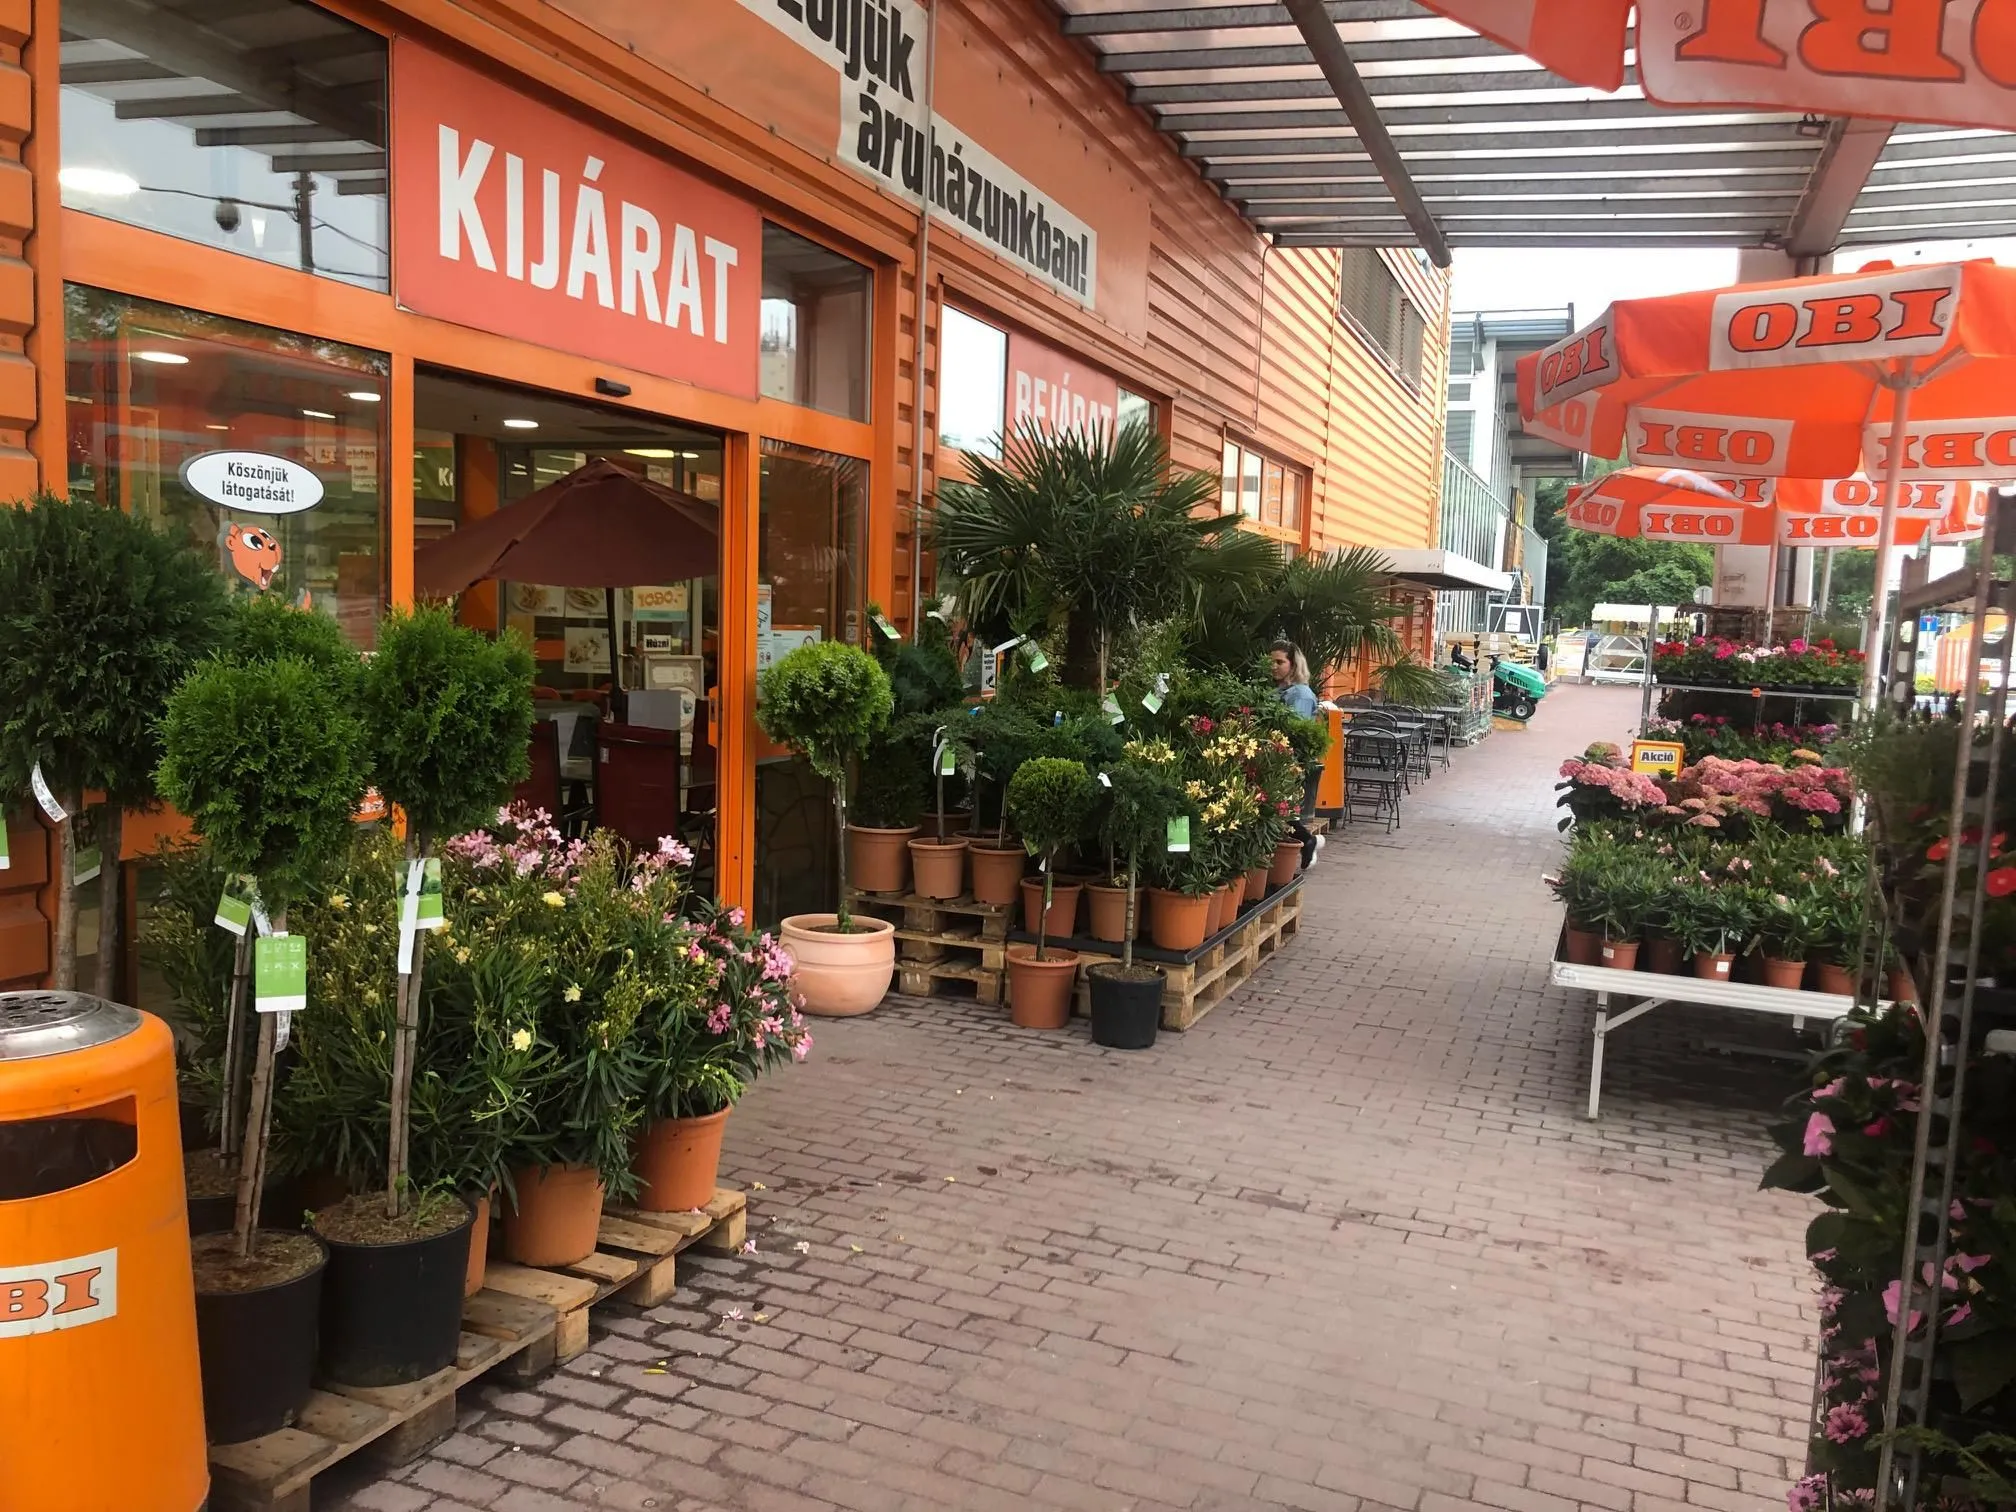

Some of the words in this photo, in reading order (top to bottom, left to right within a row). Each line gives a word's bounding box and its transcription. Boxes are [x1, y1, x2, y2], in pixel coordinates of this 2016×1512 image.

[777, 0, 915, 103] ljük
[857, 80, 1089, 297] áruházunkban!
[438, 123, 738, 345] KIJÁRAT
[1727, 286, 1952, 353] OBI
[1540, 326, 1610, 396] OBI
[1015, 370, 1112, 459] BEJÁRAT
[222, 481, 295, 502] látogatását!
[228, 462, 289, 485] Köszönjük
[1641, 751, 1674, 762] Akció
